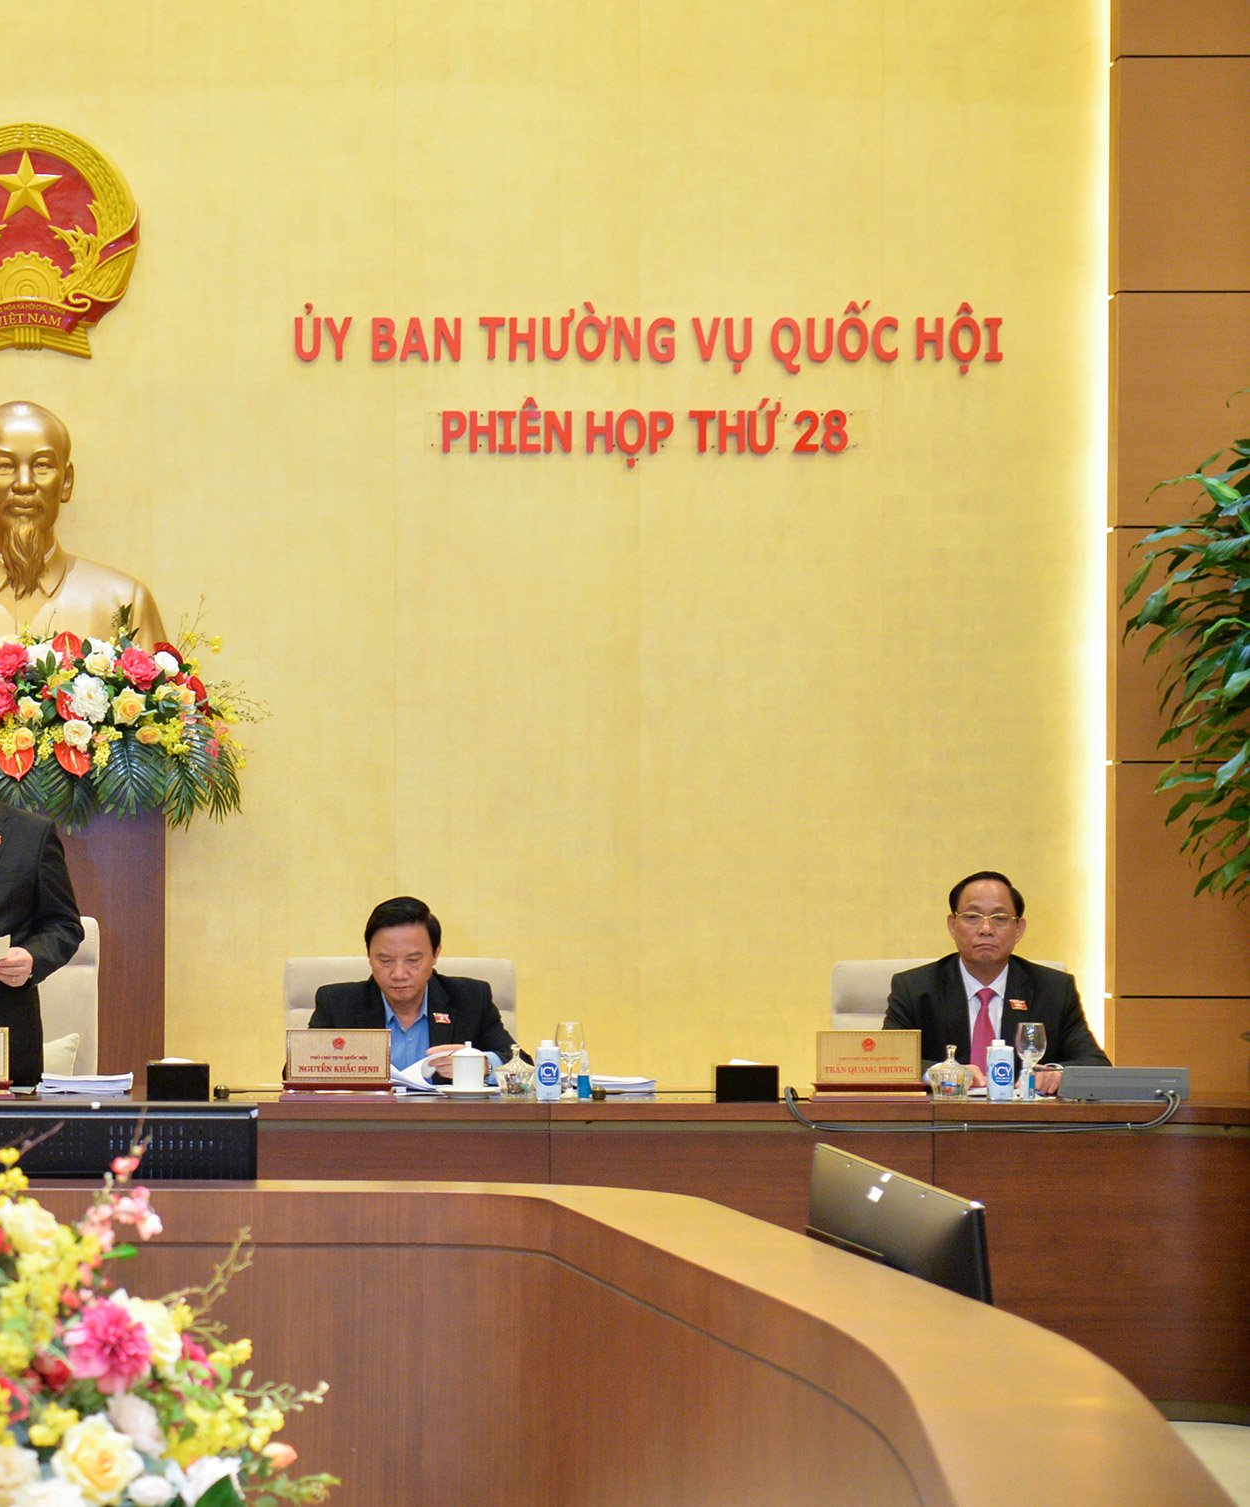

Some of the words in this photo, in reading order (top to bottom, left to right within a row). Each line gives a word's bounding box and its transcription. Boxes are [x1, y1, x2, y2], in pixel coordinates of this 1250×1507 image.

[27, 313, 62, 327] NAM
[295, 301, 352, 361] ỦY
[371, 317, 462, 361] BAN
[480, 302, 676, 362] THƯỜNG
[693, 317, 753, 372] VỤ
[770, 300, 899, 374] QUỐC
[916, 303, 1003, 373] HỘI
[442, 397, 573, 455] PHIÊN
[586, 409, 675, 468] HỌP
[688, 398, 782, 455] THỨ
[793, 409, 849, 454] 28
[540, 1066, 557, 1077] ICY
[848, 1066, 877, 1074] QUANG
[994, 1066, 1011, 1077] ICY
